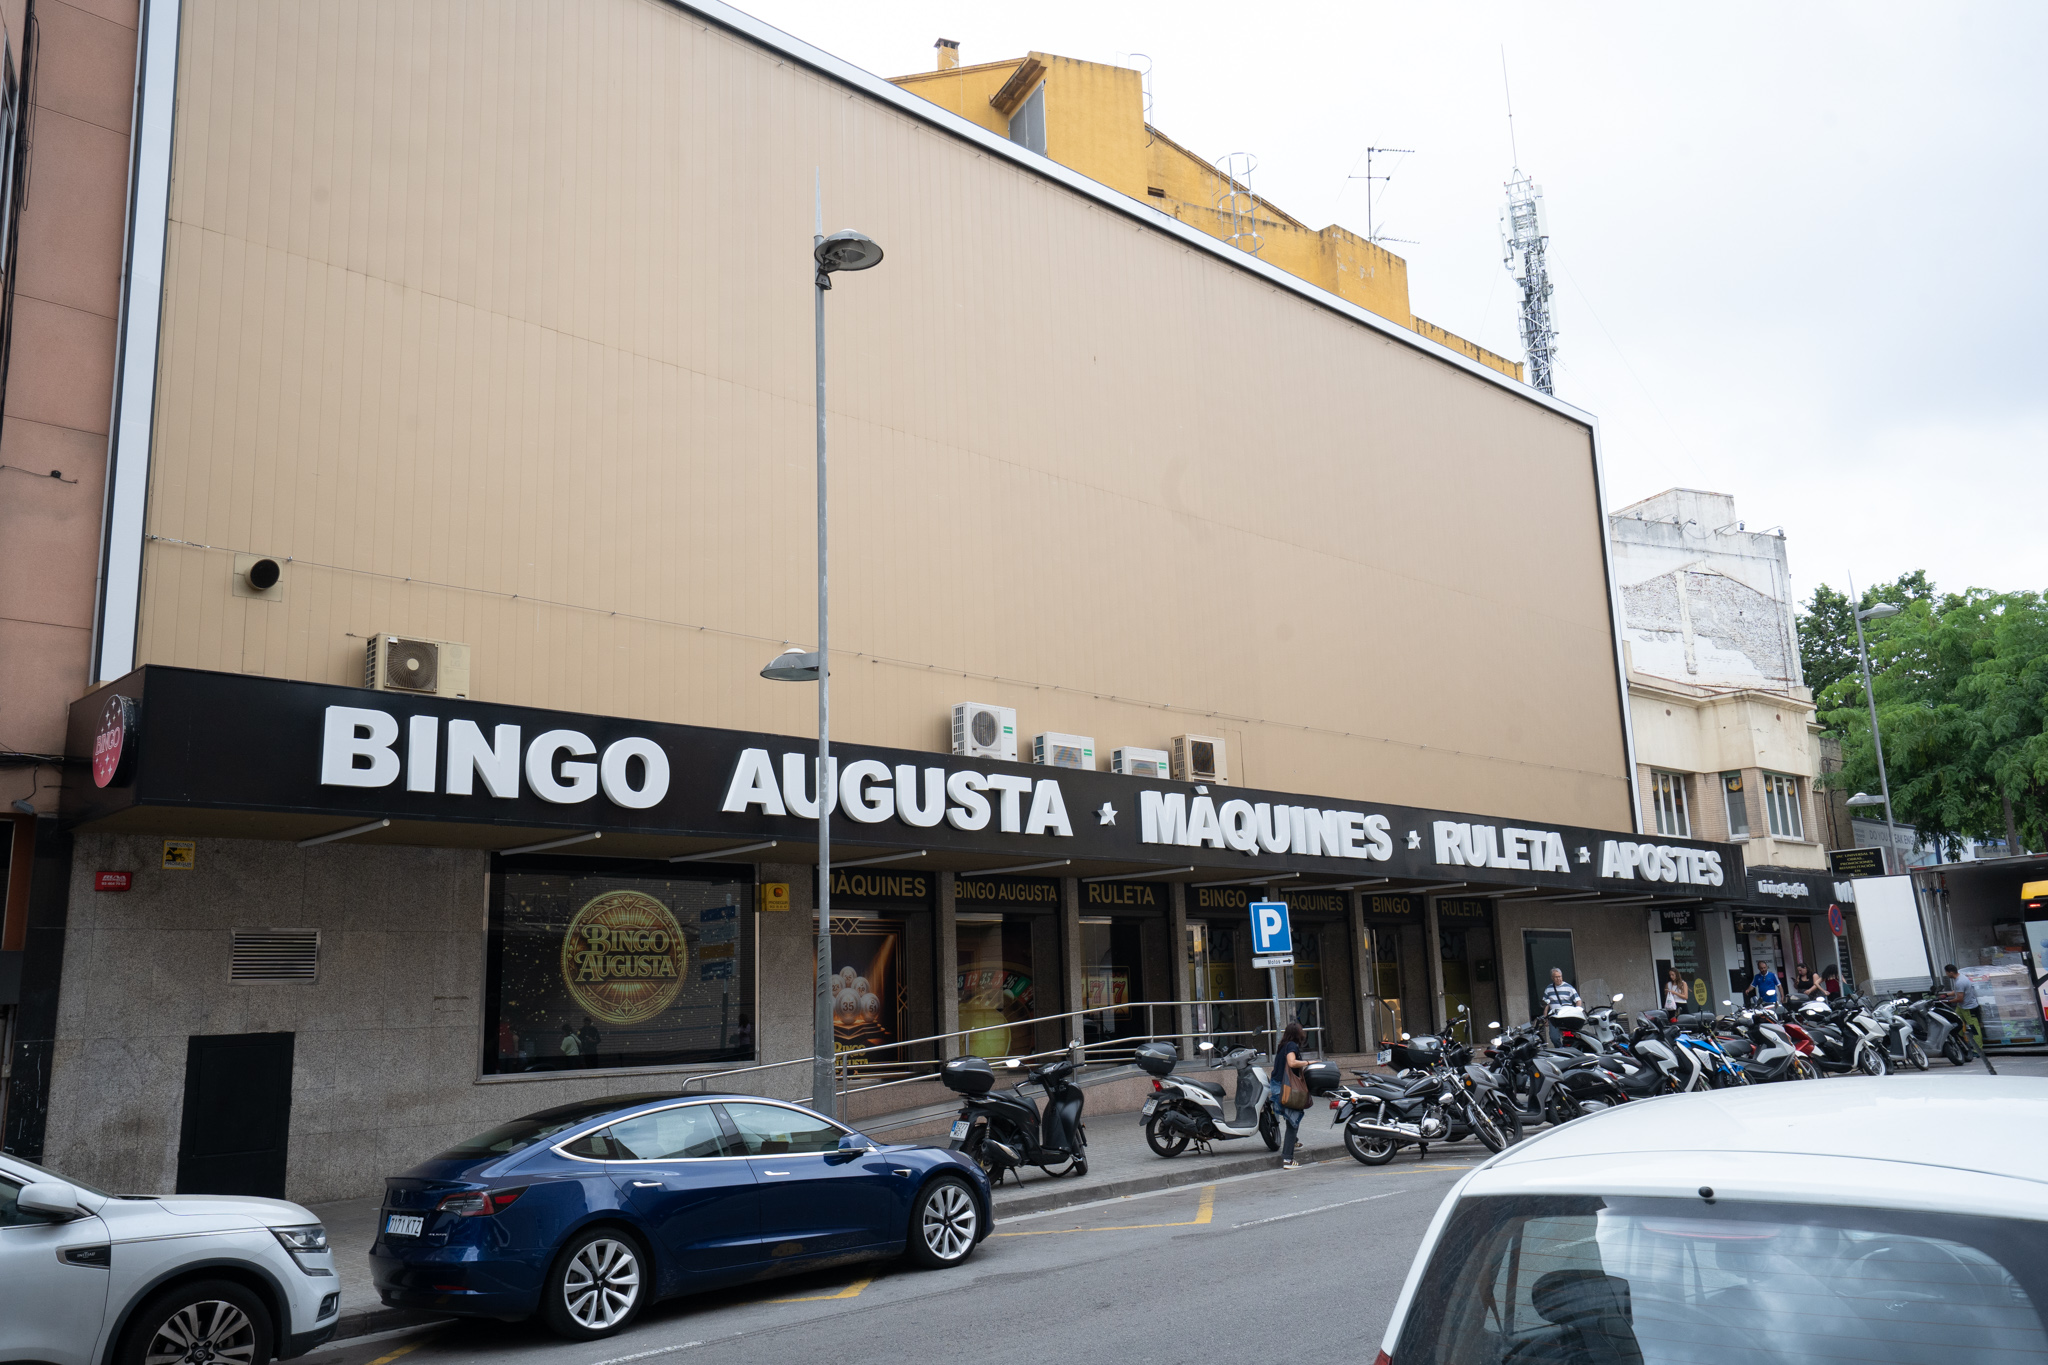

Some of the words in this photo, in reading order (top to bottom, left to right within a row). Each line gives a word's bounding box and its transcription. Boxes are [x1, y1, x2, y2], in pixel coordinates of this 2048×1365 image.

[95, 726, 121, 756] BINGO
[321, 705, 671, 808] BINGO
[721, 748, 1073, 837] AUGUSTA
[1139, 785, 1393, 863] MÀQUINES
[1433, 820, 1571, 873] RULETA
[1600, 840, 1724, 887] APOSTES
[955, 882, 996, 900] BINGO
[999, 883, 1058, 902] AUGUSTA
[1089, 884, 1155, 905] RULETA
[1199, 888, 1247, 908] BINGO
[1372, 896, 1411, 914] BINGO
[1441, 901, 1484, 917] RULETA
[1663, 910, 1691, 919] What's
[1258, 908, 1283, 948] P
[1673, 916, 1688, 926] Up!
[581, 923, 670, 956] BINGO
[574, 950, 677, 982] AUGUSTA
[967, 973, 978, 987] 12
[1005, 975, 1018, 989] 26
[1090, 980, 1106, 1004] 7
[1112, 980, 1127, 1004] 7
[842, 1001, 855, 1012] 35
[868, 1004, 877, 1013] 51
[389, 1217, 405, 1233] 7171
[405, 1219, 422, 1234] KTZ
